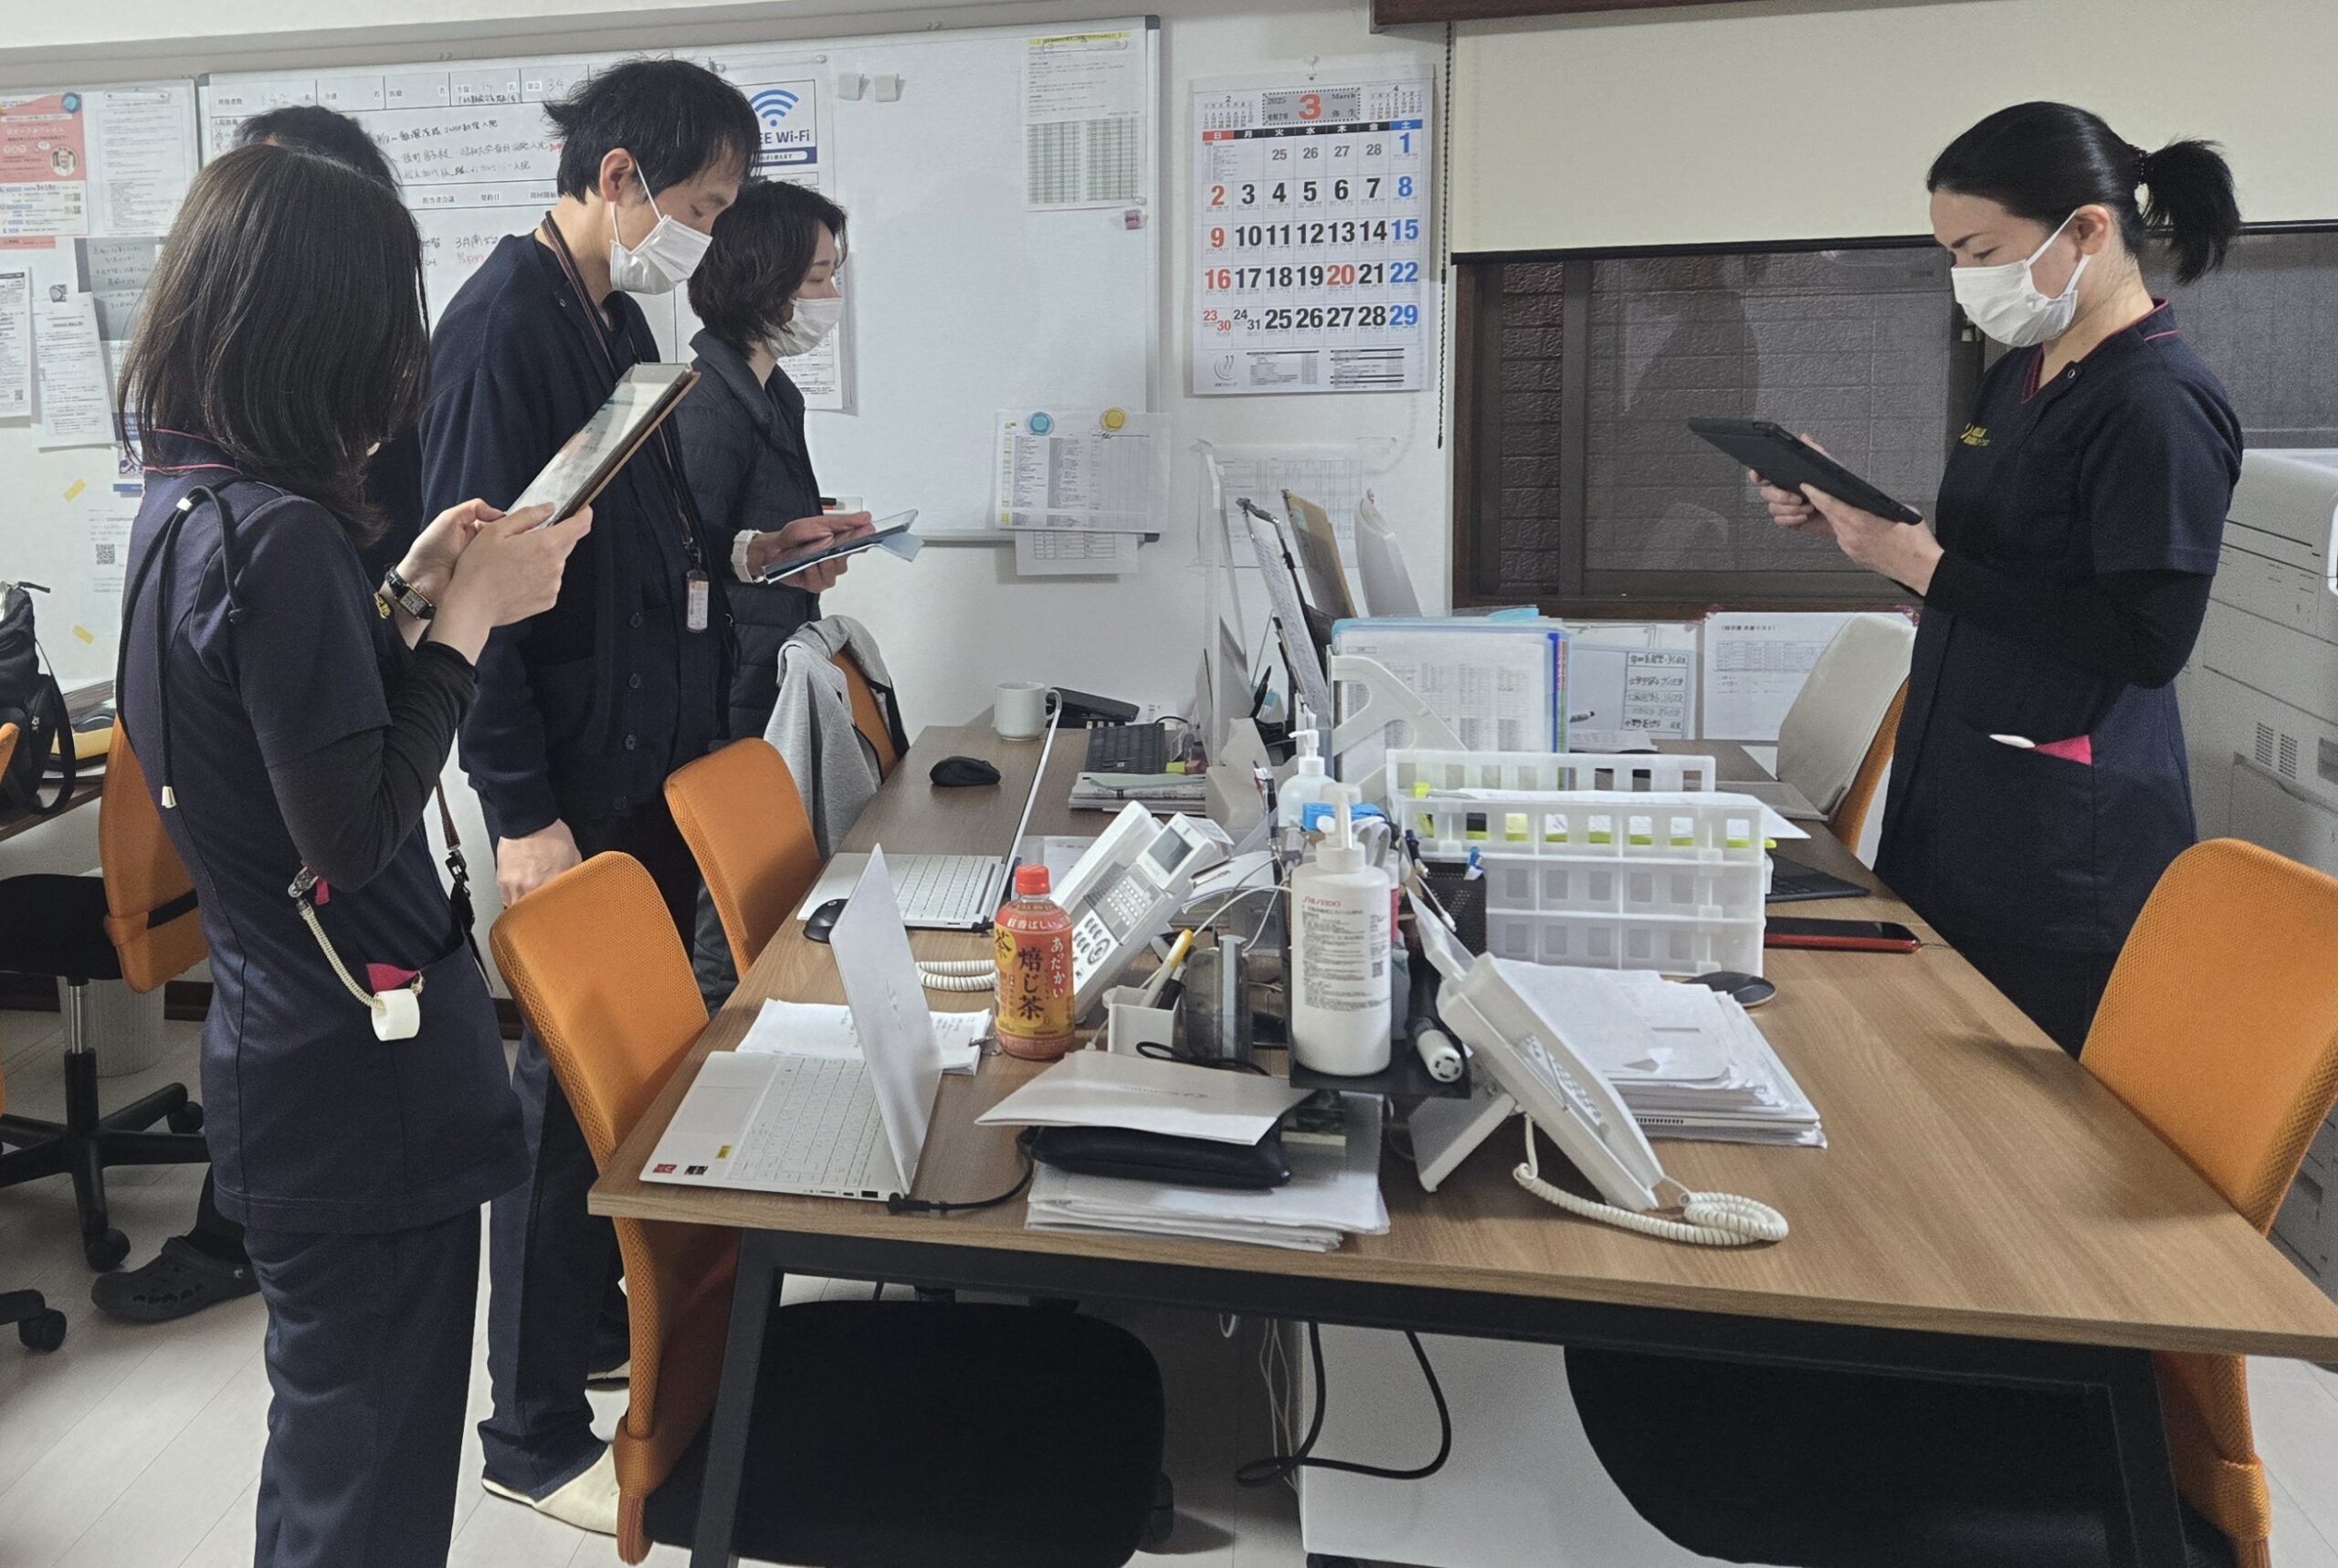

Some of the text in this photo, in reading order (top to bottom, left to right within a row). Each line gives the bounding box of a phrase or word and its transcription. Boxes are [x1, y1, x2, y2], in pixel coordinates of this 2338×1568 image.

[1299, 93, 1322, 120] 3
[776, 129, 810, 143] Wi-Fi
[1306, 127, 1315, 135] 水
[1401, 121, 1410, 130] 土
[1272, 132, 1409, 160] 25 26 27 28 1
[1211, 176, 1413, 205] 2 3 4 5 6 7 8
[1211, 219, 1418, 247] 9 10 11 12 13 14 15
[1205, 262, 1418, 289] 16 17 18 19 20 21 22
[1204, 305, 1418, 330] 23 24 25 26 27 28 29
[1217, 319, 1260, 331] 30 31
[1051, 936, 1066, 999] あったかい
[1016, 947, 1045, 1021] 焙じ茶
